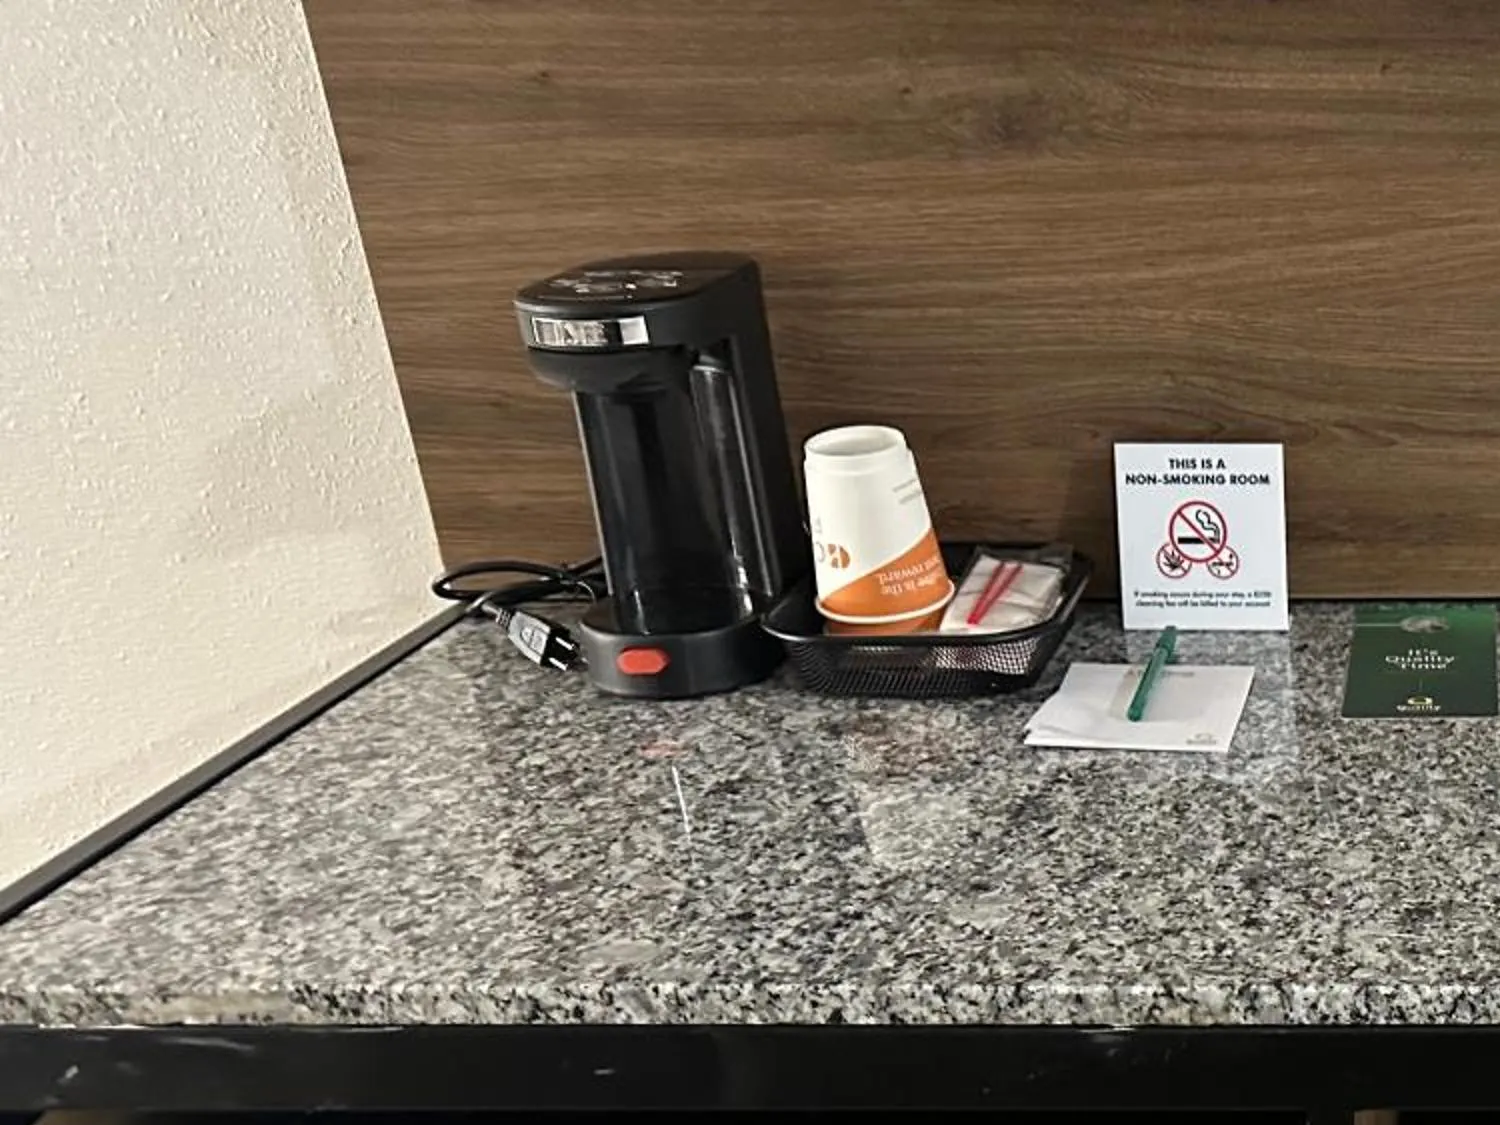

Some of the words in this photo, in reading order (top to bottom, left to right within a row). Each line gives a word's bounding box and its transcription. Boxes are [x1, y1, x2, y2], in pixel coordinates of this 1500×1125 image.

[1168, 458, 1197, 470] THIS
[1201, 458, 1213, 470] IS
[1216, 458, 1227, 470] A
[1125, 474, 1226, 485] NON-SMOKING
[1229, 474, 1270, 485] ROOM
[1385, 655, 1456, 665] Quality
